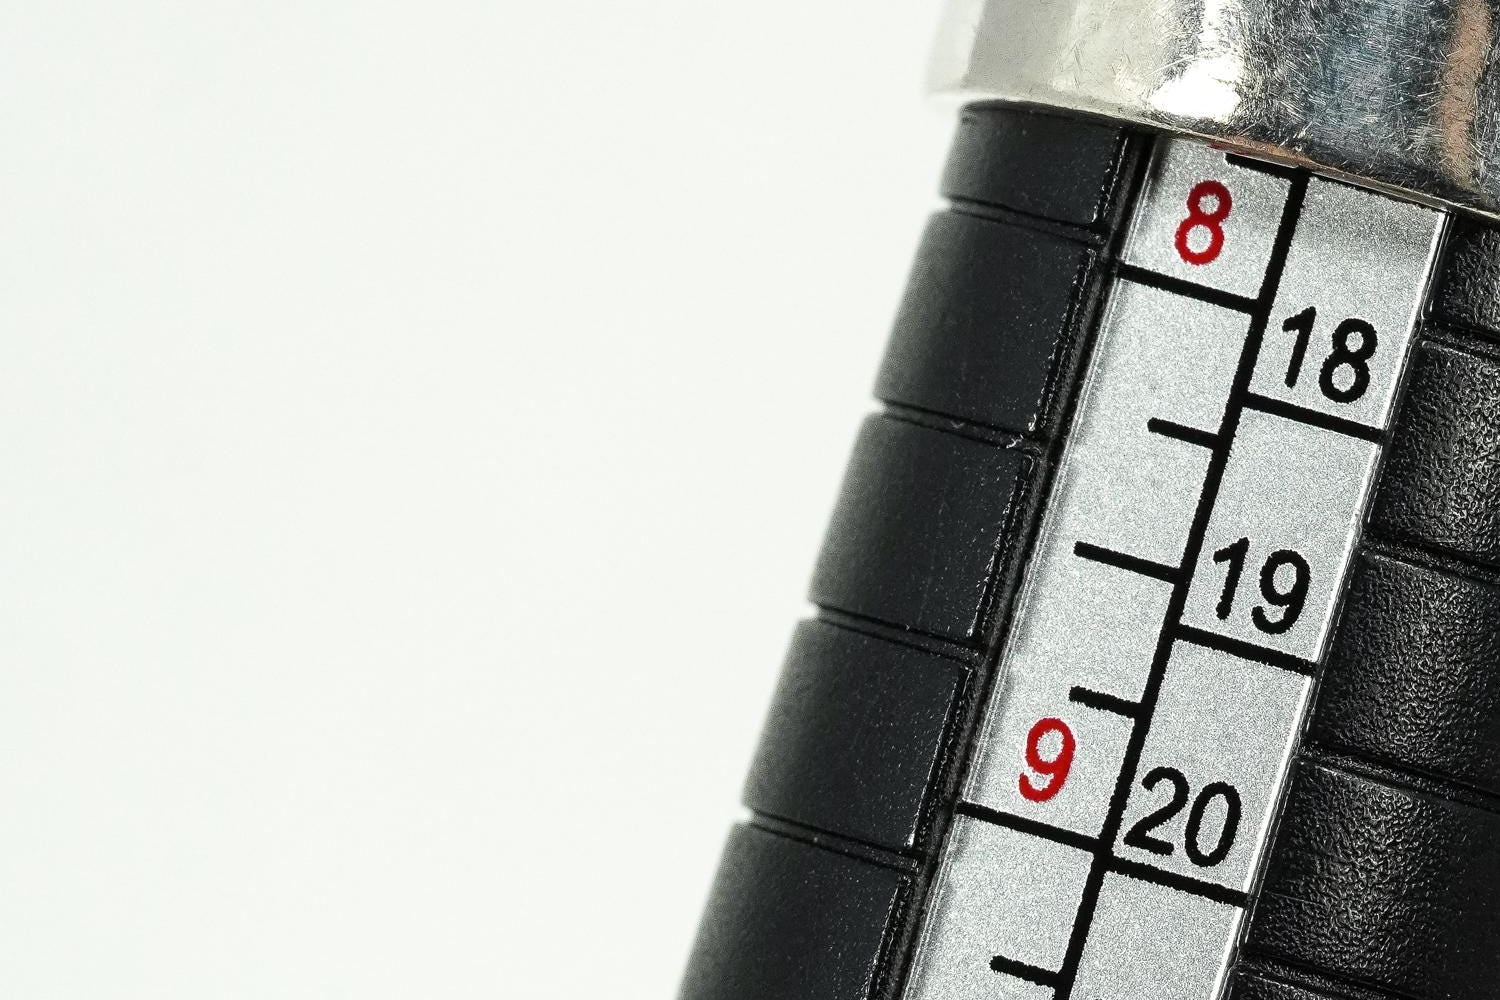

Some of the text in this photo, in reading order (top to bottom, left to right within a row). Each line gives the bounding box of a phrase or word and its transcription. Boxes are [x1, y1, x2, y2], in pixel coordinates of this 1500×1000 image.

[1175, 181, 1232, 265] 8
[1282, 307, 1378, 404] 18
[1213, 537, 1311, 635] 19
[1019, 718, 1075, 802] 9
[1123, 767, 1242, 868] 20
